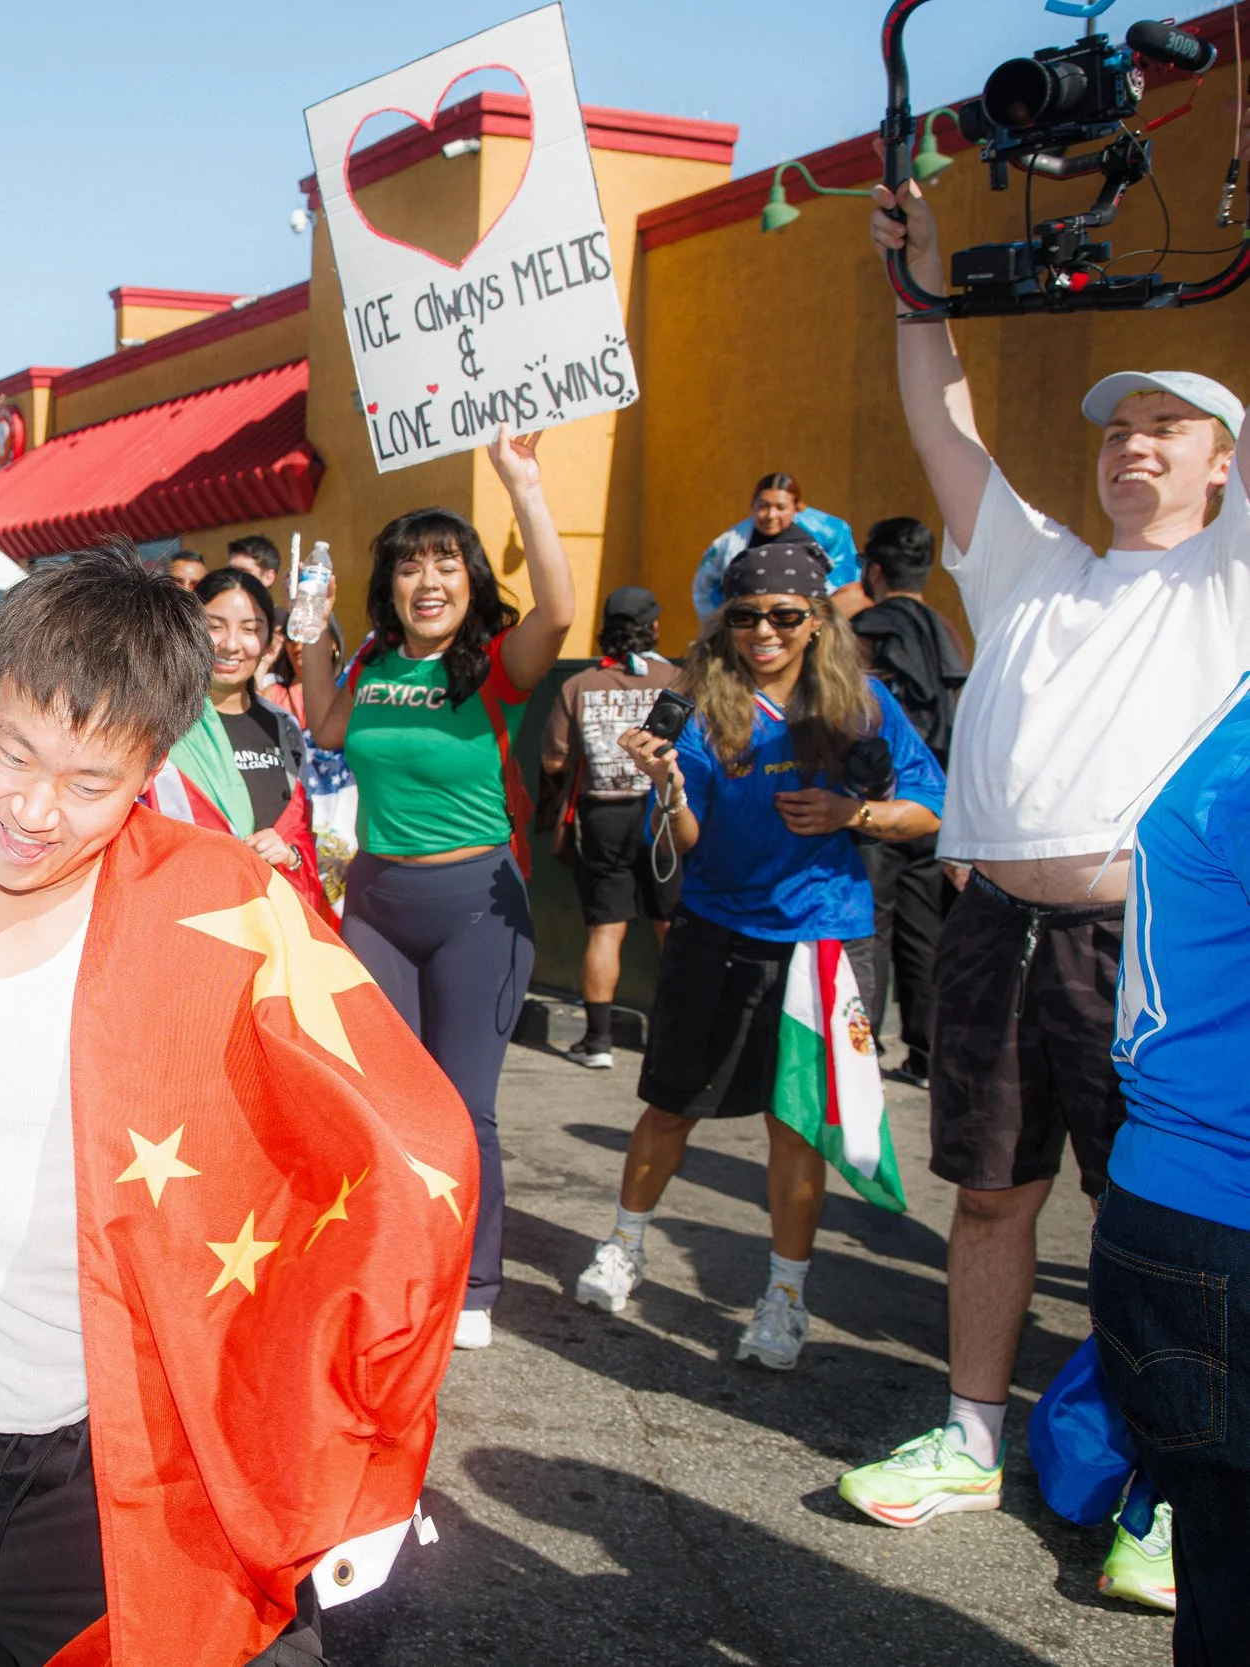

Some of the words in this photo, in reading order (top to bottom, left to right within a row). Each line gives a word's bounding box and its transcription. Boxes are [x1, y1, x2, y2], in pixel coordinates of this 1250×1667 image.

[354, 293, 400, 352] ICE
[414, 274, 504, 332] always
[511, 231, 612, 306] MELTS
[458, 324, 484, 381] &
[372, 400, 440, 460] LOVE
[451, 382, 538, 438] always
[542, 347, 625, 409] WINS
[582, 690, 606, 706] THE
[608, 688, 653, 706] PEOPLE
